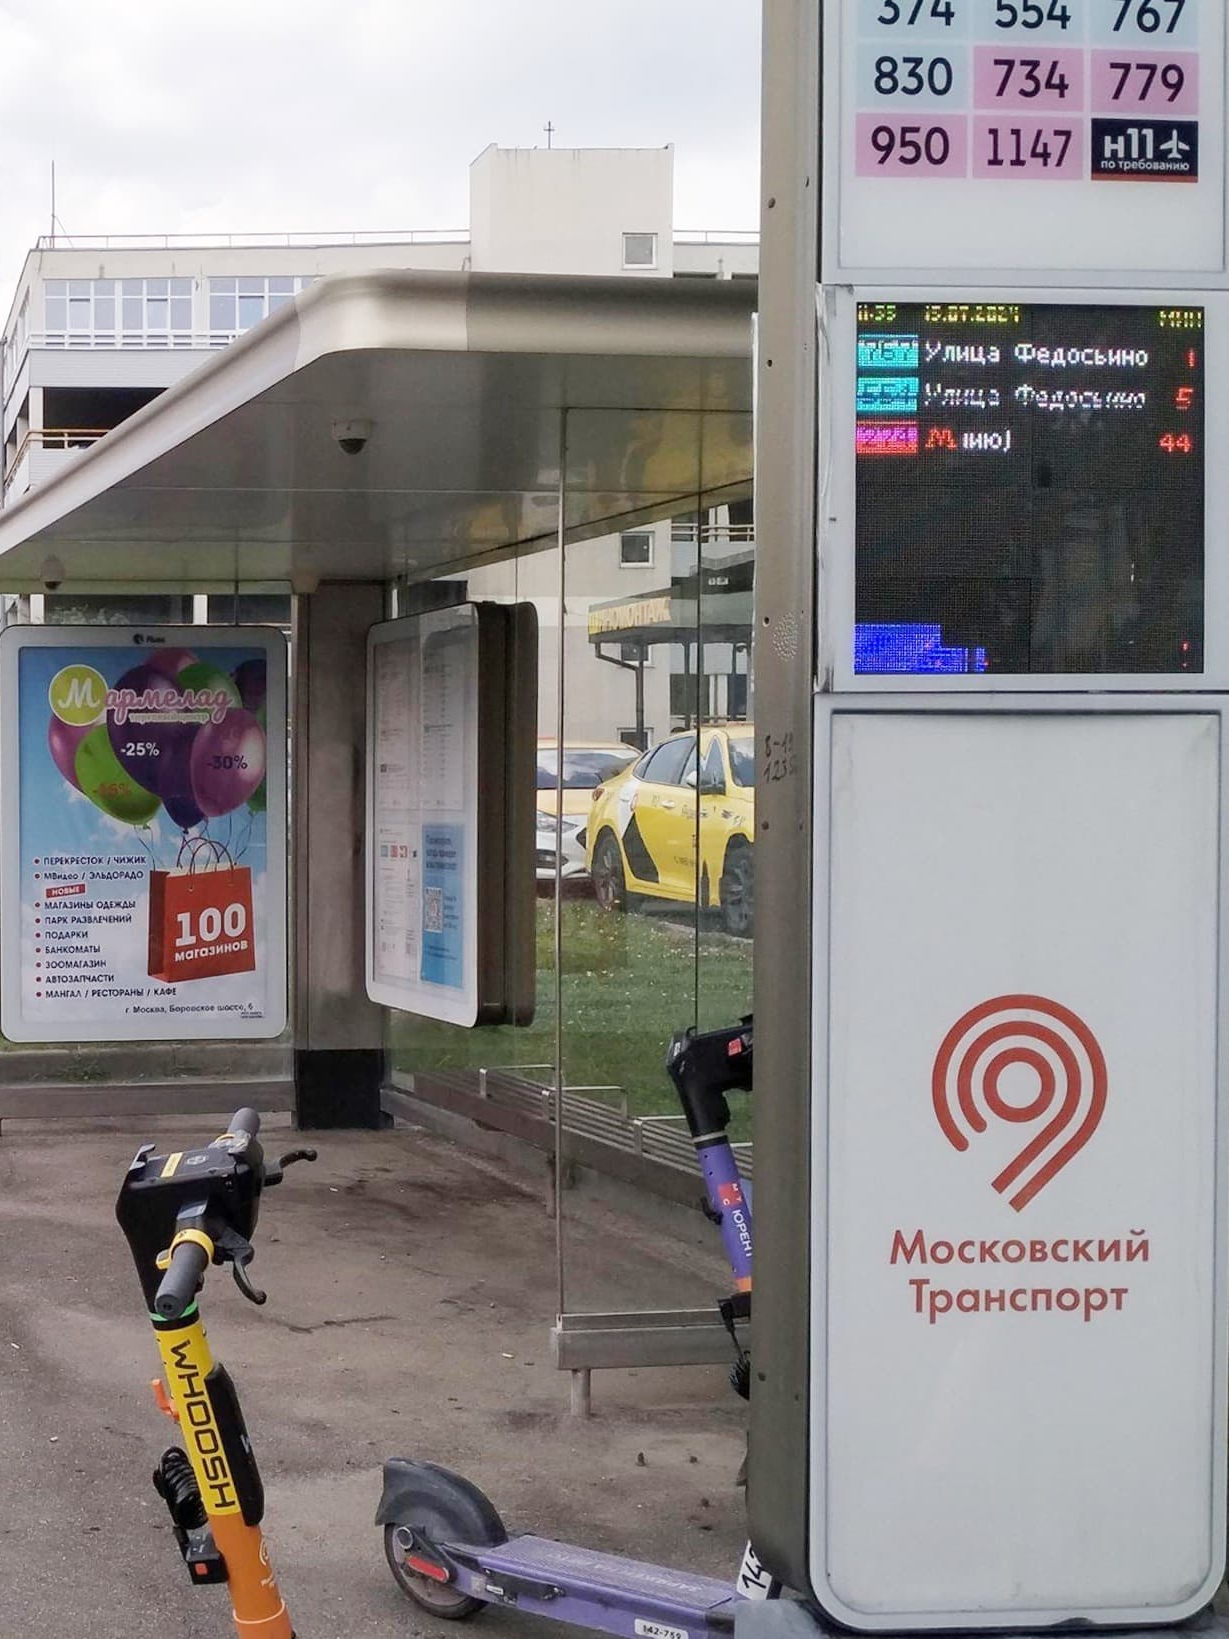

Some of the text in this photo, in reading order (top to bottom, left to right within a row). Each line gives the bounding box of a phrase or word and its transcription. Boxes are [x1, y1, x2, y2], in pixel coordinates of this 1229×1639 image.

[995, 0, 1071, 29] 554
[1112, 0, 1186, 33] 767
[874, 56, 1185, 102] 830 734 779
[871, 125, 1073, 168] 950 1147
[1101, 158, 1190, 171] по требованию
[925, 341, 1000, 366] Улица
[1014, 343, 1149, 368] Федосьино
[924, 383, 1000, 409] Улица
[1159, 433, 1191, 452] 44
[57, 677, 232, 724] Мармелад
[121, 742, 160, 756] -25%
[43, 856, 105, 866] ПЕРЕКРЕСТОК
[113, 856, 147, 865] ЧИЖИК
[89, 871, 144, 881] ЭЛЬДОРАДО
[44, 900, 136, 910] МАГАЗИНЫ ОДЕЖДЫ
[45, 913, 132, 925] ПАРК РАЗВЛЕЧЕНИЙ
[175, 903, 246, 947] 100
[45, 931, 89, 940] ПОДАРКИ
[45, 945, 101, 954] БАНКОМАТЫ
[175, 940, 248, 962] магазинов
[45, 960, 107, 969] ЗООМАГАЗИН
[45, 975, 115, 984] АВТОЗАПЧАСТИ
[46, 990, 82, 998] МАНГАЛ
[91, 988, 144, 998] РЕСТОРАНЫ
[153, 987, 177, 996] КАФЕ
[889, 1228, 1150, 1265] Московский
[909, 1278, 1128, 1324] Транспорт
[170, 1339, 236, 1509] WHOOSH
